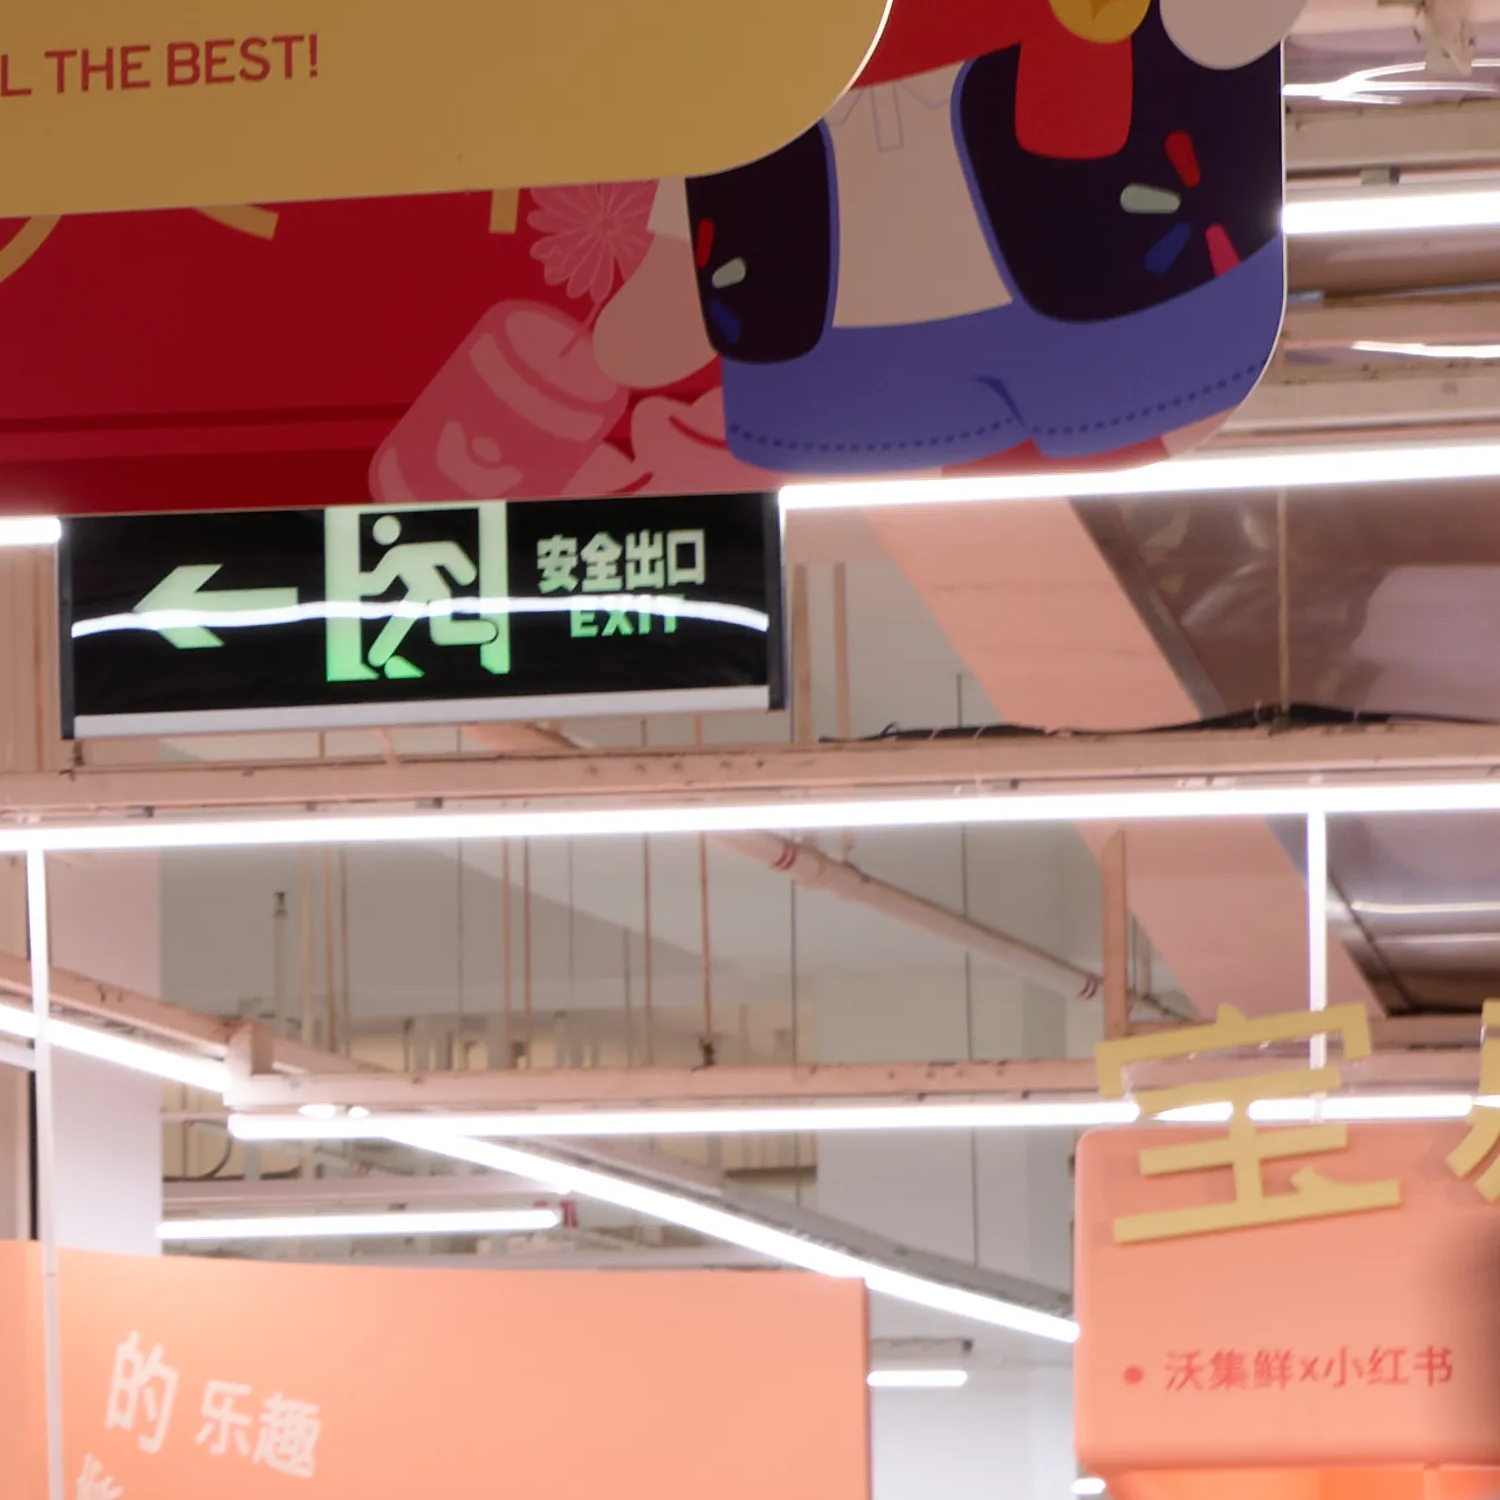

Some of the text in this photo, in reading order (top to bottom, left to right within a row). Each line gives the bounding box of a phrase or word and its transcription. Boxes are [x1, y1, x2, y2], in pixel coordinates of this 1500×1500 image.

[44, 44, 152, 95] THE
[165, 33, 320, 87] BEST!
[537, 528, 706, 594] 安全出口
[569, 592, 686, 638] EXIT
[1095, 1000, 1500, 1245] 宝
